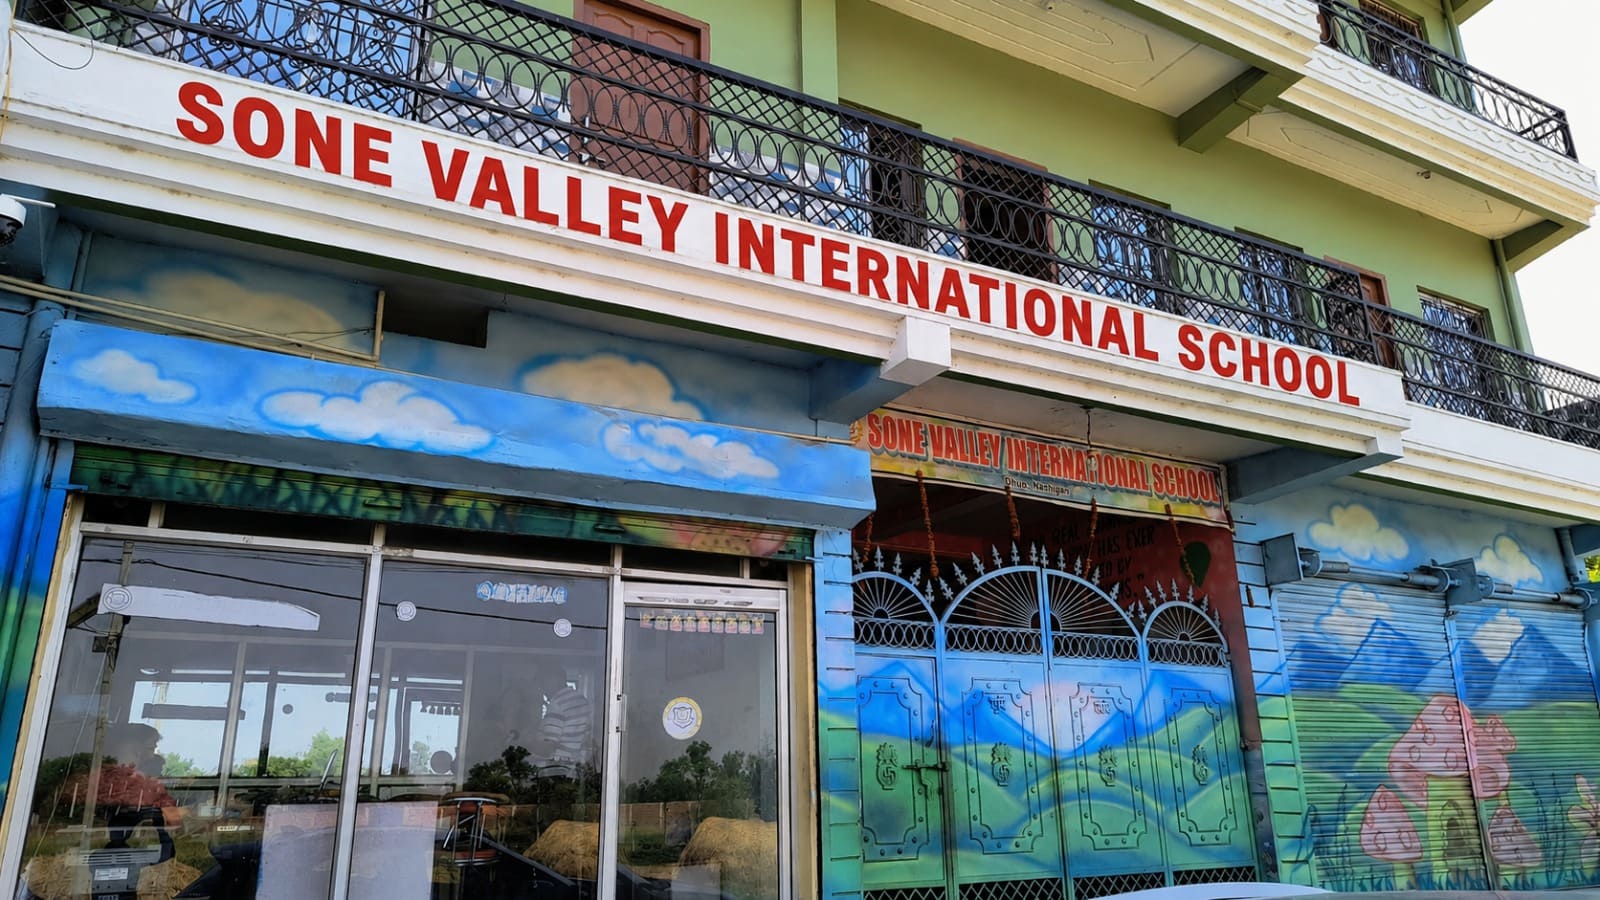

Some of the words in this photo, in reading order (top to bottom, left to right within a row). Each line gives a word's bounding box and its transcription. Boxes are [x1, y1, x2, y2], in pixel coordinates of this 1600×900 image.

[176, 81, 392, 188] SONE
[422, 141, 688, 253] VALLEY
[715, 212, 1159, 361] INTERNATIONAL
[1178, 324, 1361, 406] SCHOOL
[867, 413, 928, 458] SONE
[928, 422, 1002, 468] VALLEY
[1151, 463, 1221, 503] SCHOOL
